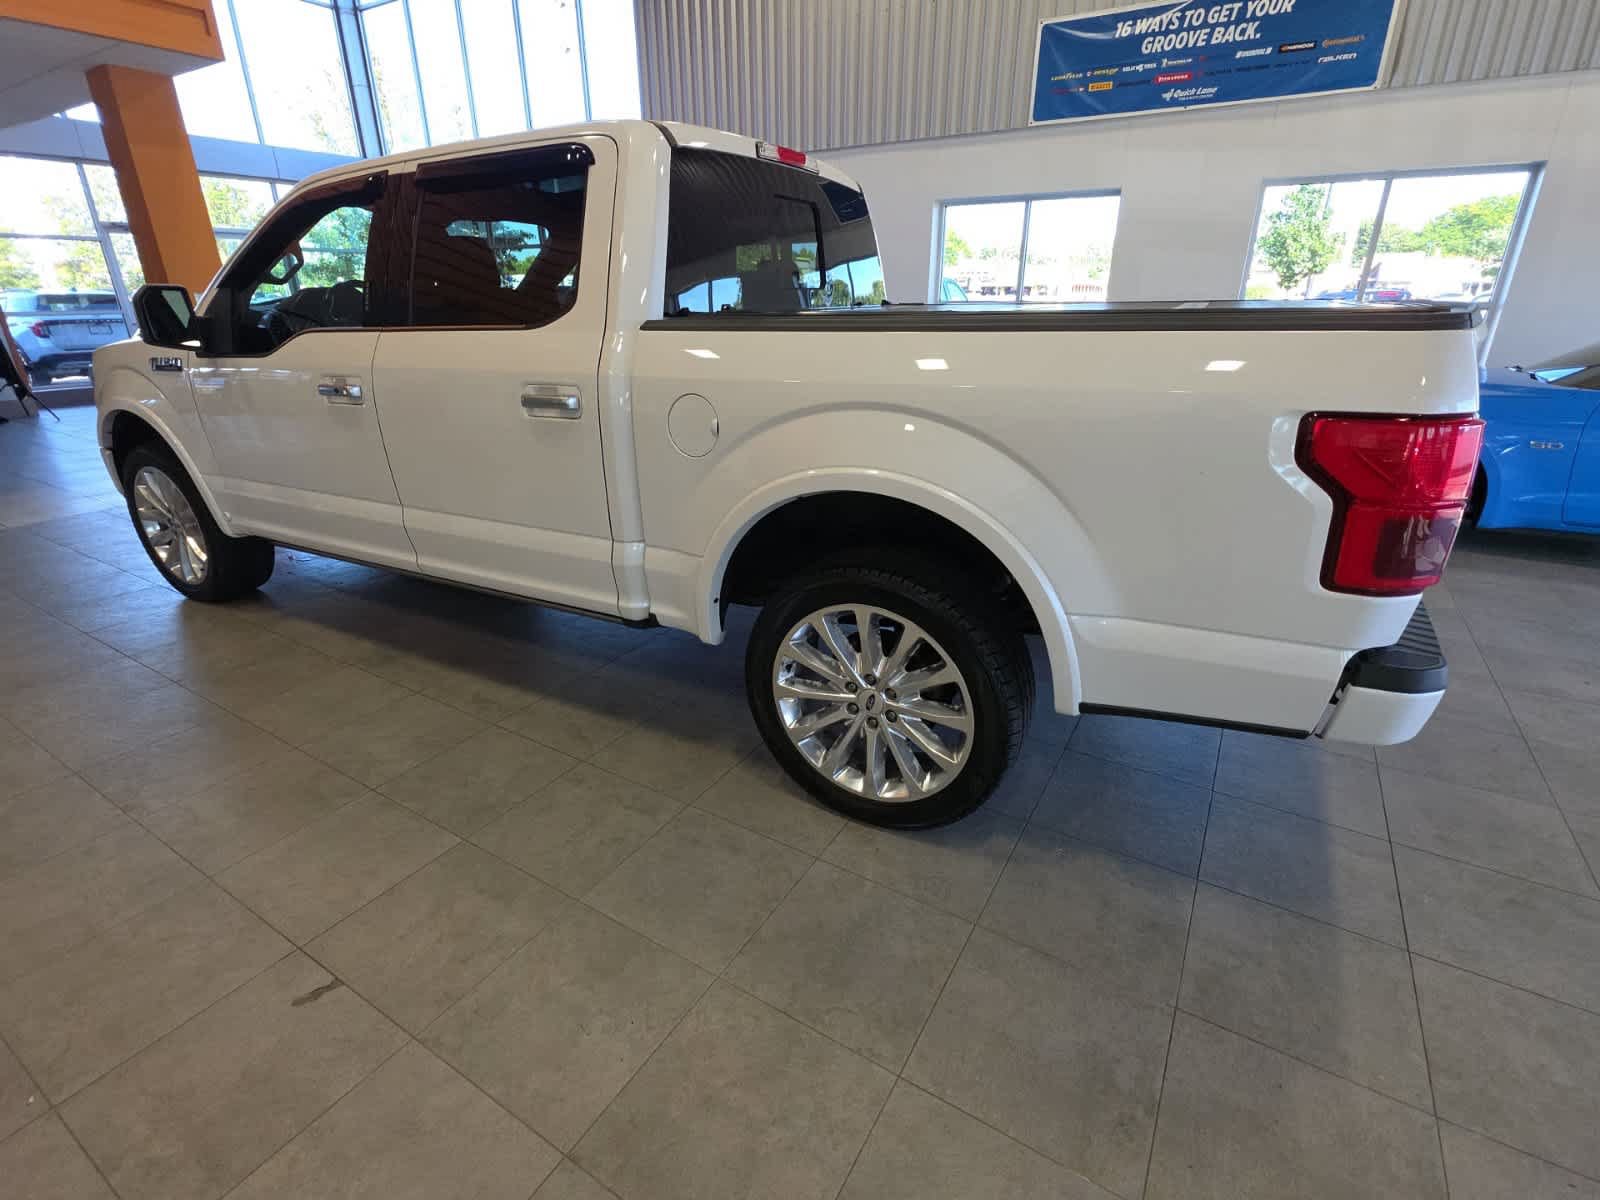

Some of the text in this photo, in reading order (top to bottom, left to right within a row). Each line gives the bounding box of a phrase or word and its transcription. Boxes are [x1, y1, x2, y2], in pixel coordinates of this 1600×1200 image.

[1114, 0, 1297, 39] 16 WAYS TO GET YOUR
[1141, 28, 1211, 54] GROOVE
[1210, 21, 1262, 45] BACK.
[1174, 88, 1196, 98] Quick
[1196, 86, 1218, 95] Lane
